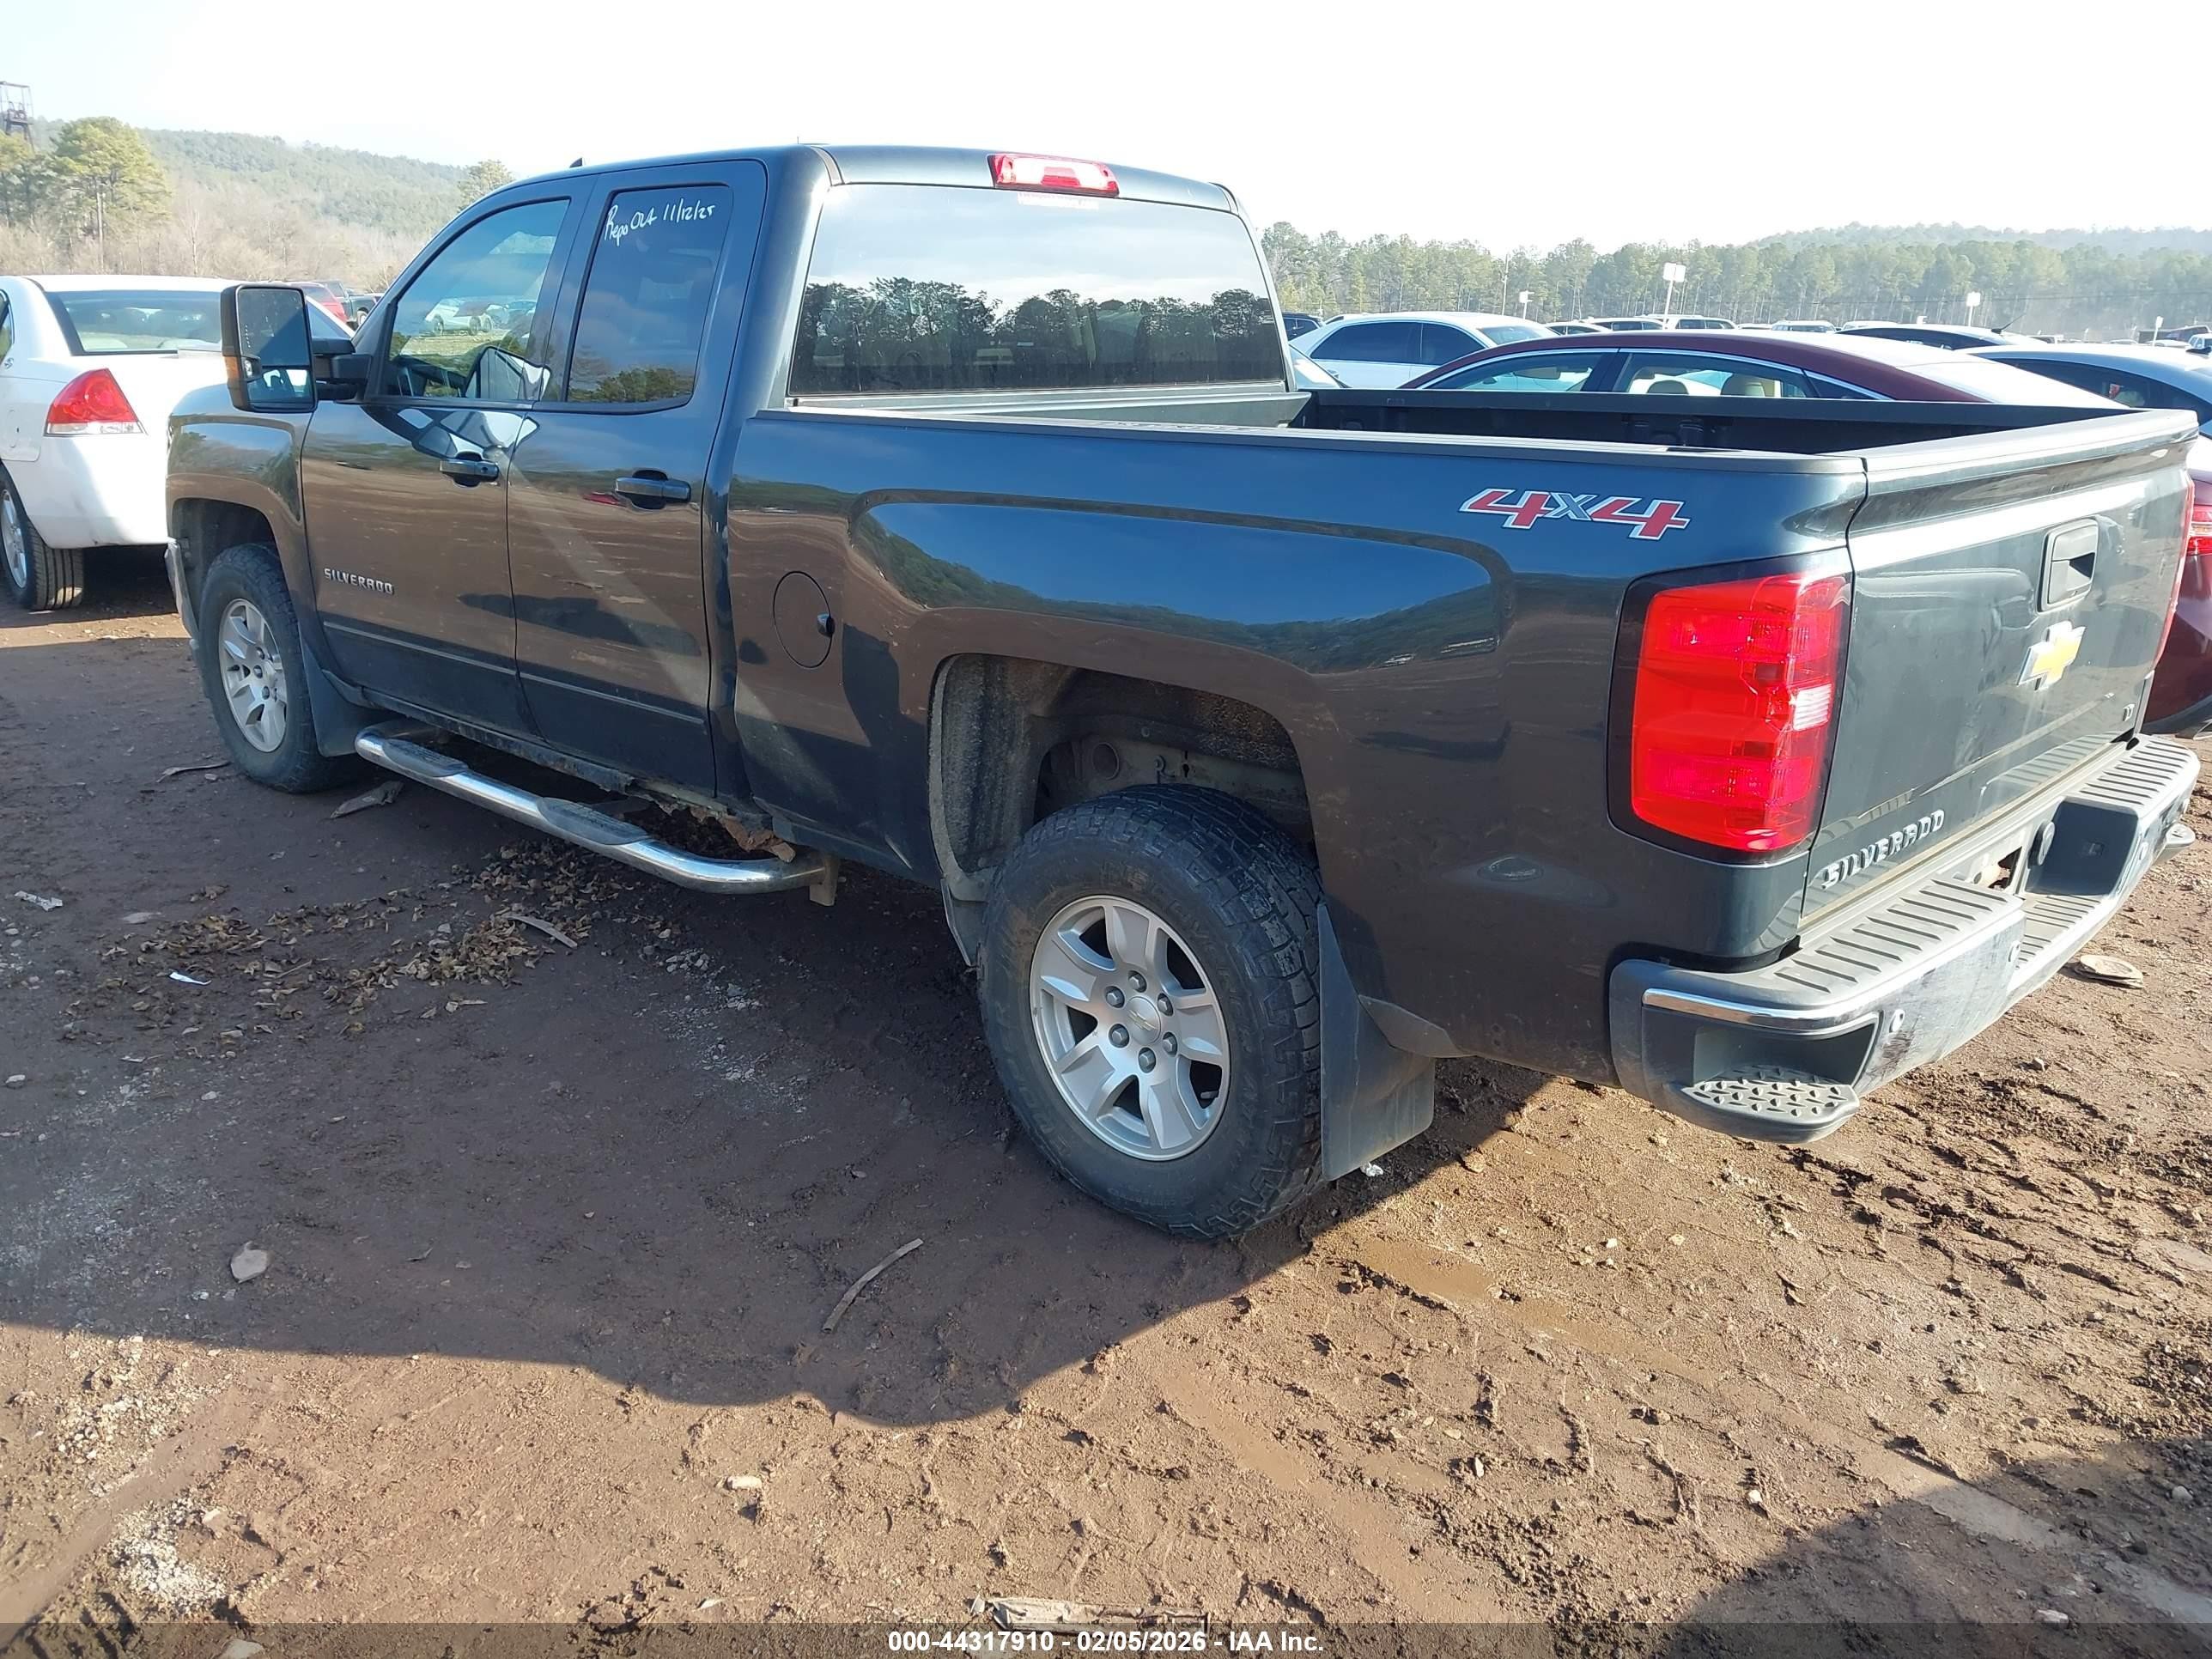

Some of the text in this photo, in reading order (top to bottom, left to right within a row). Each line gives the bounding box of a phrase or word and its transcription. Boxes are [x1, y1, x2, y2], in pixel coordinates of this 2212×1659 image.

[604, 204, 629, 246] Repo
[324, 568, 394, 595] SILVERADO
[1820, 809, 1945, 890] SILVERADO
